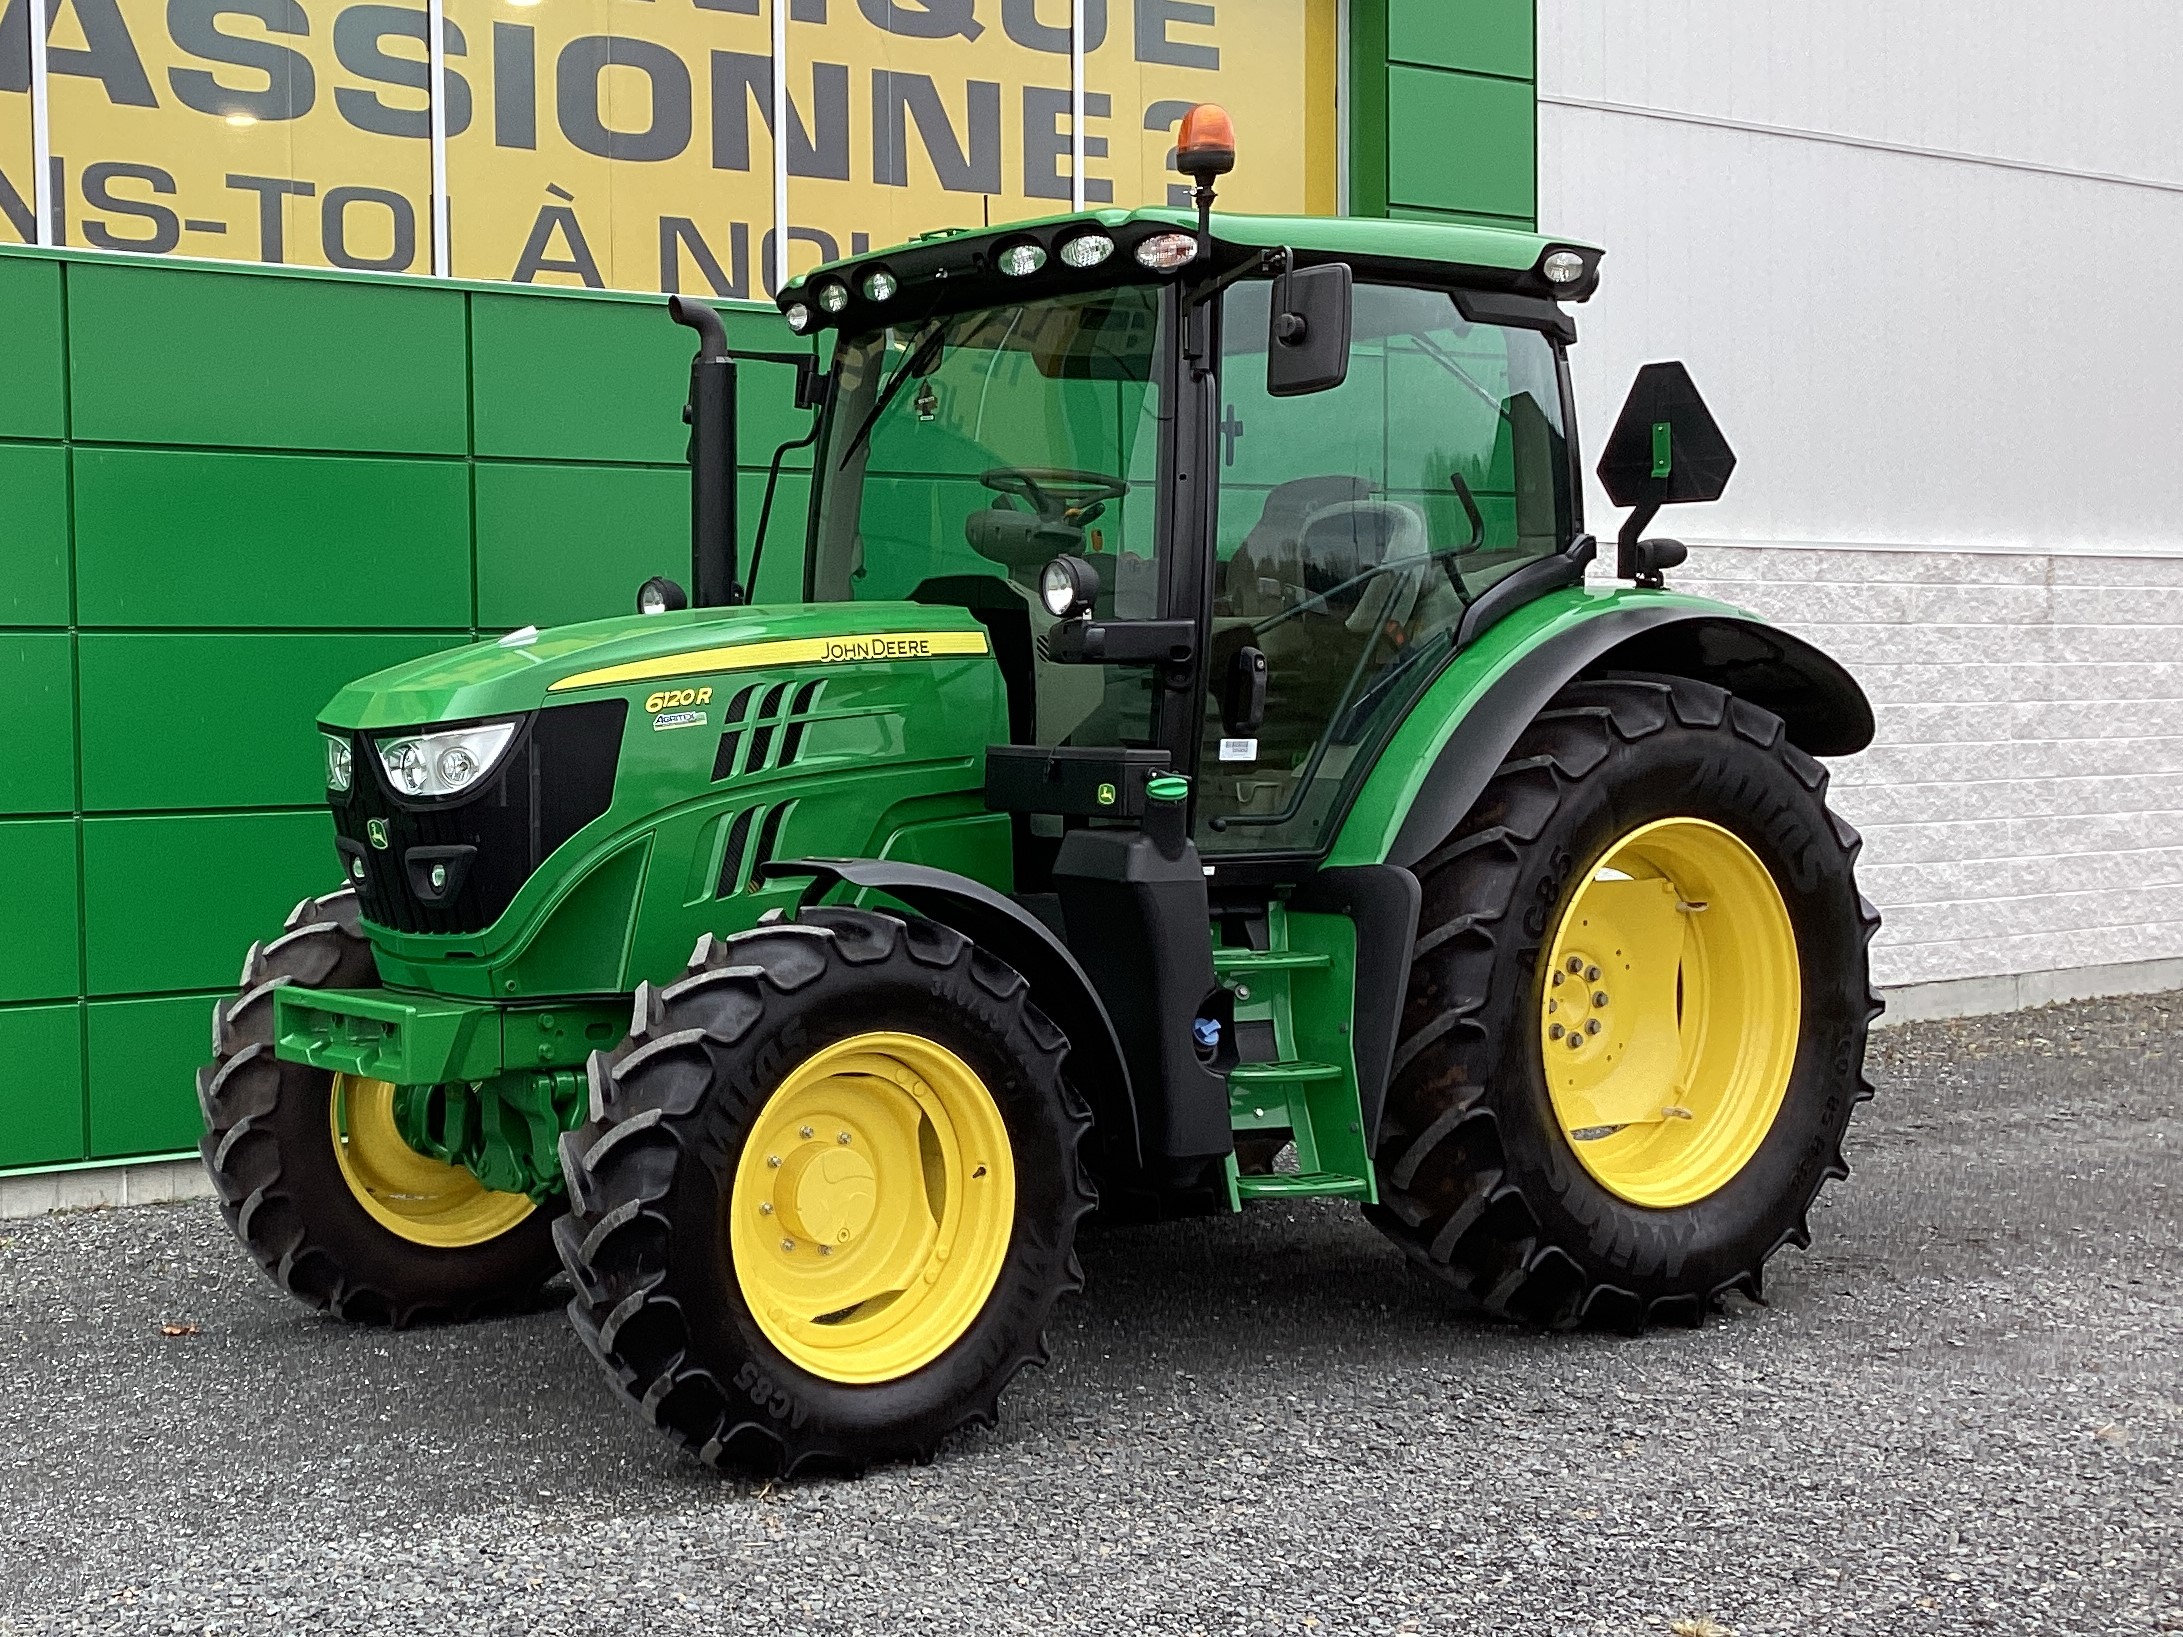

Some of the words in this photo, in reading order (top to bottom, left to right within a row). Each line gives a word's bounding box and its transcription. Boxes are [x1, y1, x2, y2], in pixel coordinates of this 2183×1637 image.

[510, 182, 606, 289] À
[659, 215, 869, 300] NO
[820, 641, 870, 659] JOHN
[871, 638, 931, 656] DEERE
